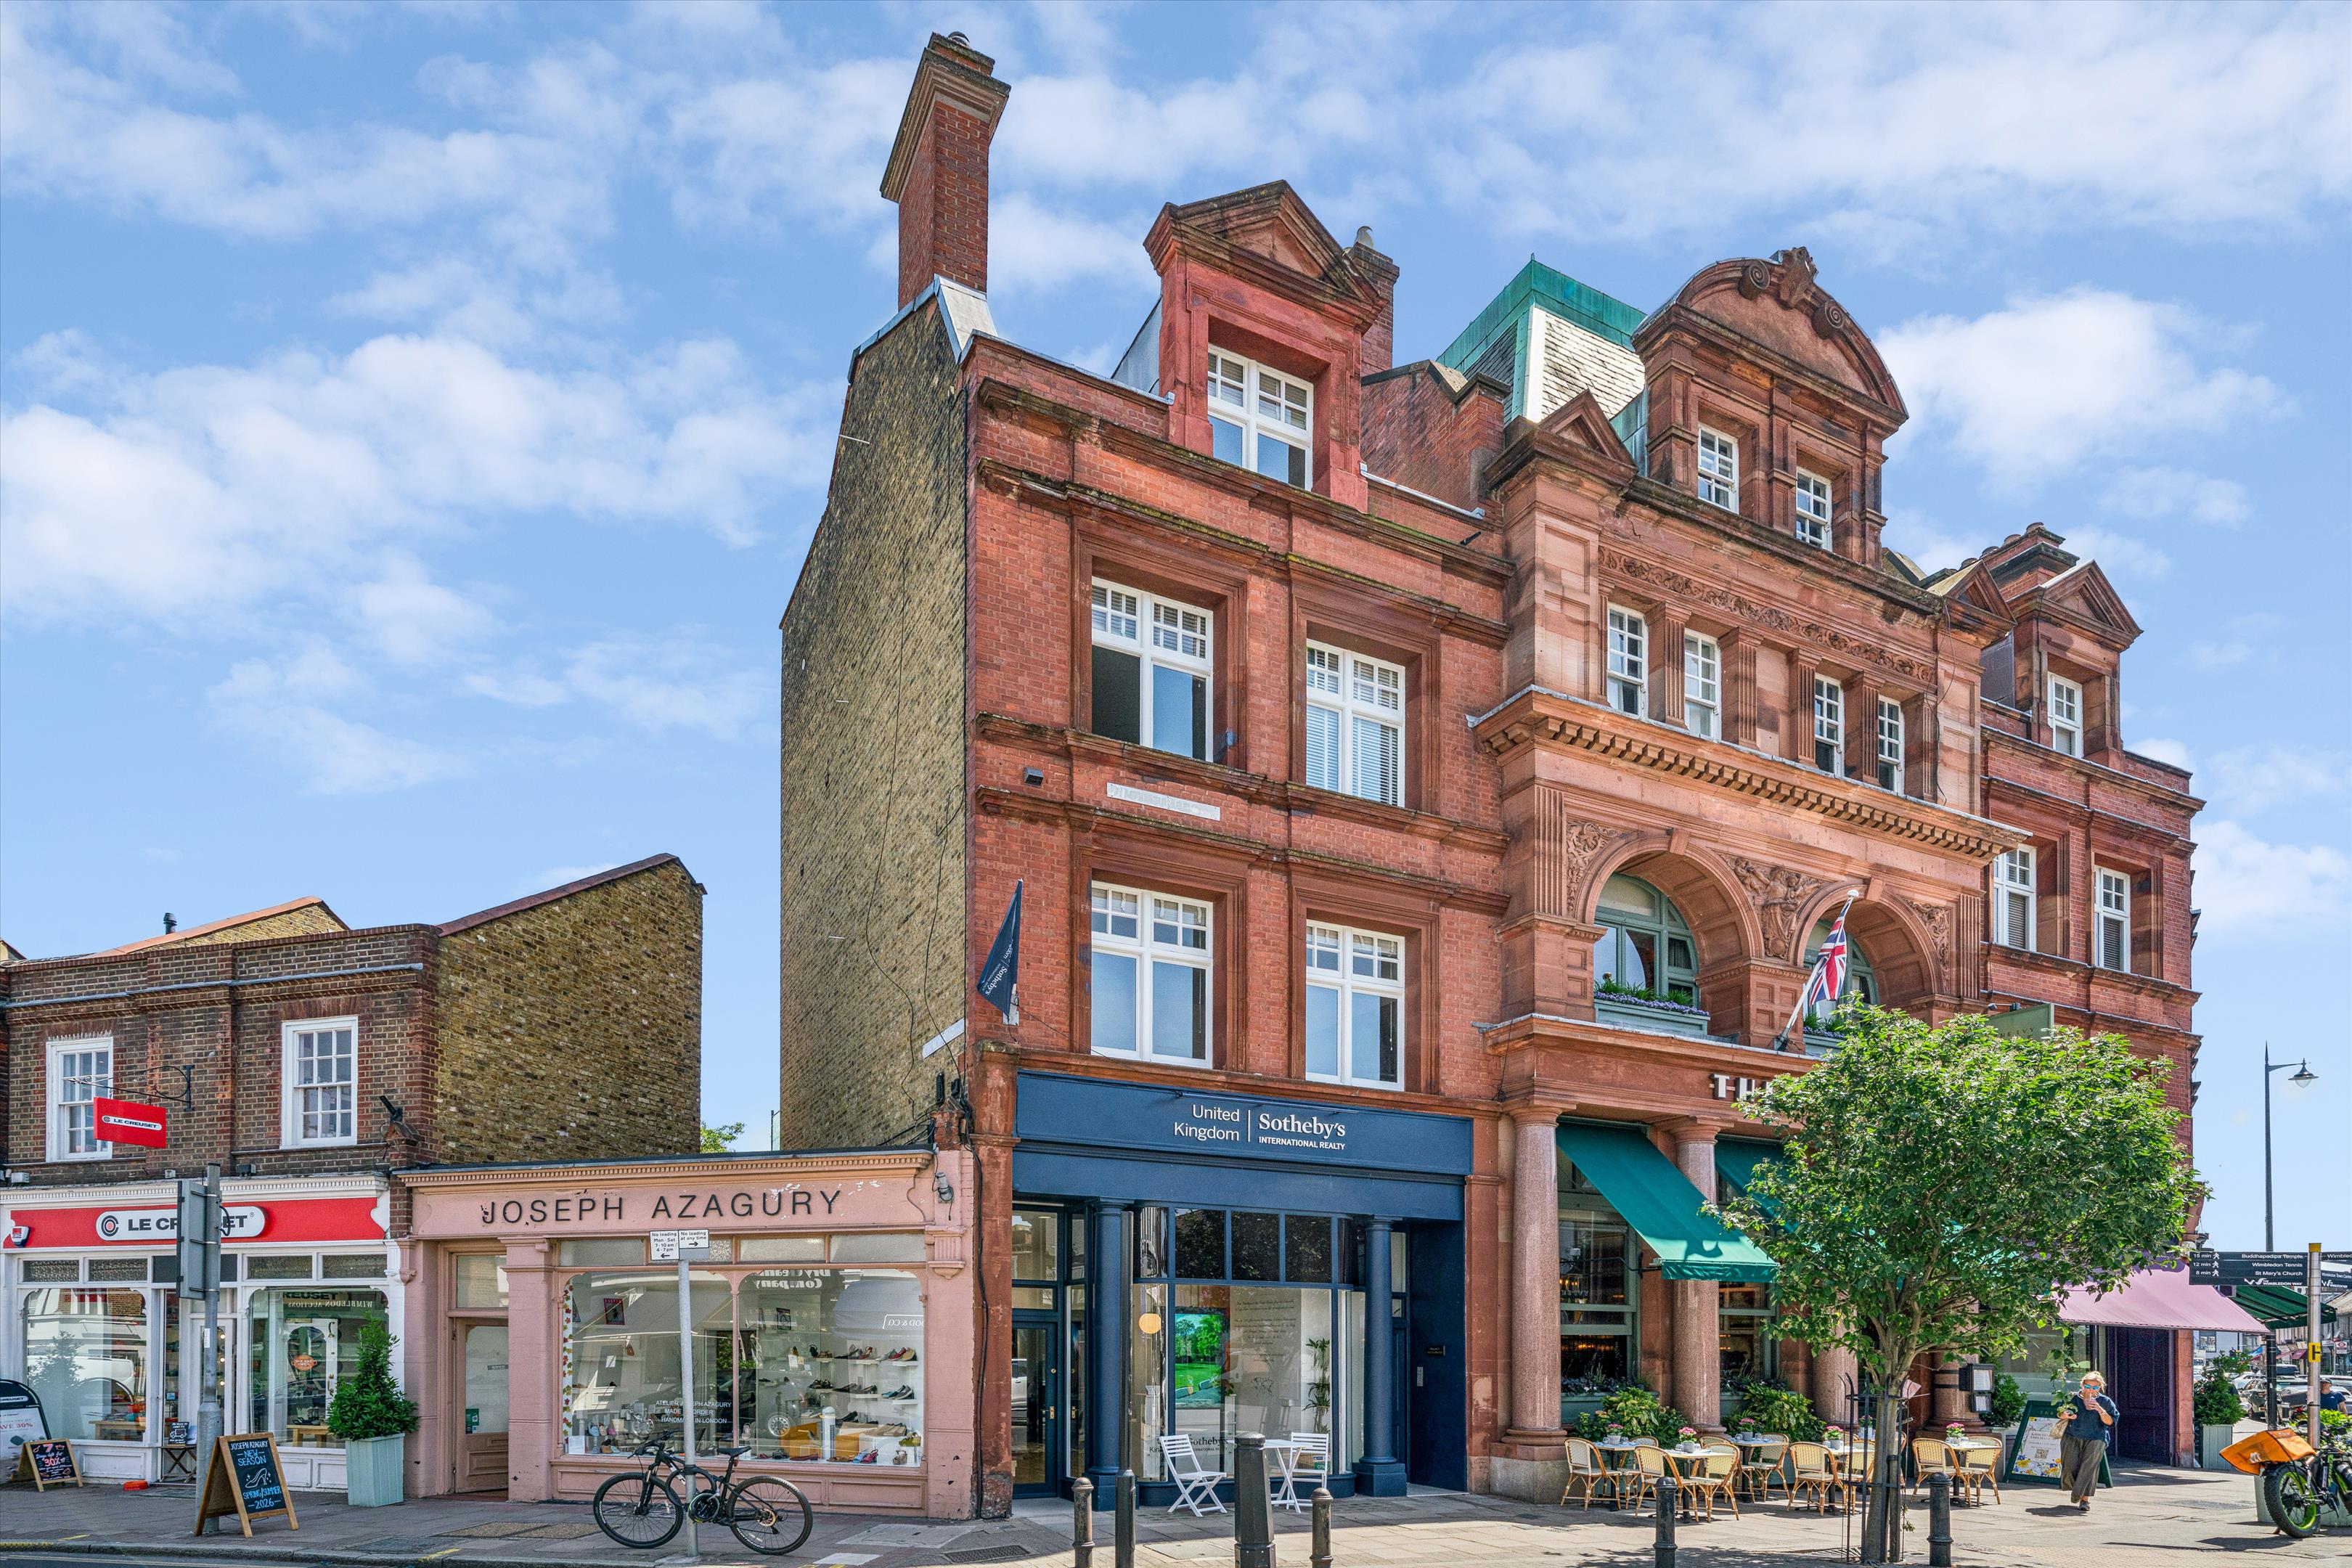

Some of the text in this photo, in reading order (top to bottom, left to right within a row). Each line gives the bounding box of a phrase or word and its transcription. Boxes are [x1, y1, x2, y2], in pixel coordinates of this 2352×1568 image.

[985, 966, 1008, 995] Sotheby's
[1710, 1073, 1773, 1101] TH
[1192, 1104, 1240, 1122] United
[1173, 1122, 1240, 1141] Kingdom
[1259, 1113, 1346, 1139] Sotheby's
[1259, 1136, 1345, 1151] INTERNATIONAL REALTY
[481, 1189, 841, 1225] JOSEPH AZAGURY
[128, 1215, 248, 1231] LE CRET
[43, 1443, 54, 1453] 7
[230, 1441, 249, 1450] JOSEPH
[237, 1455, 266, 1466] SEASON
[244, 1449, 258, 1458] NEW
[44, 1457, 61, 1467] 30%
[255, 1498, 274, 1509] 2026
